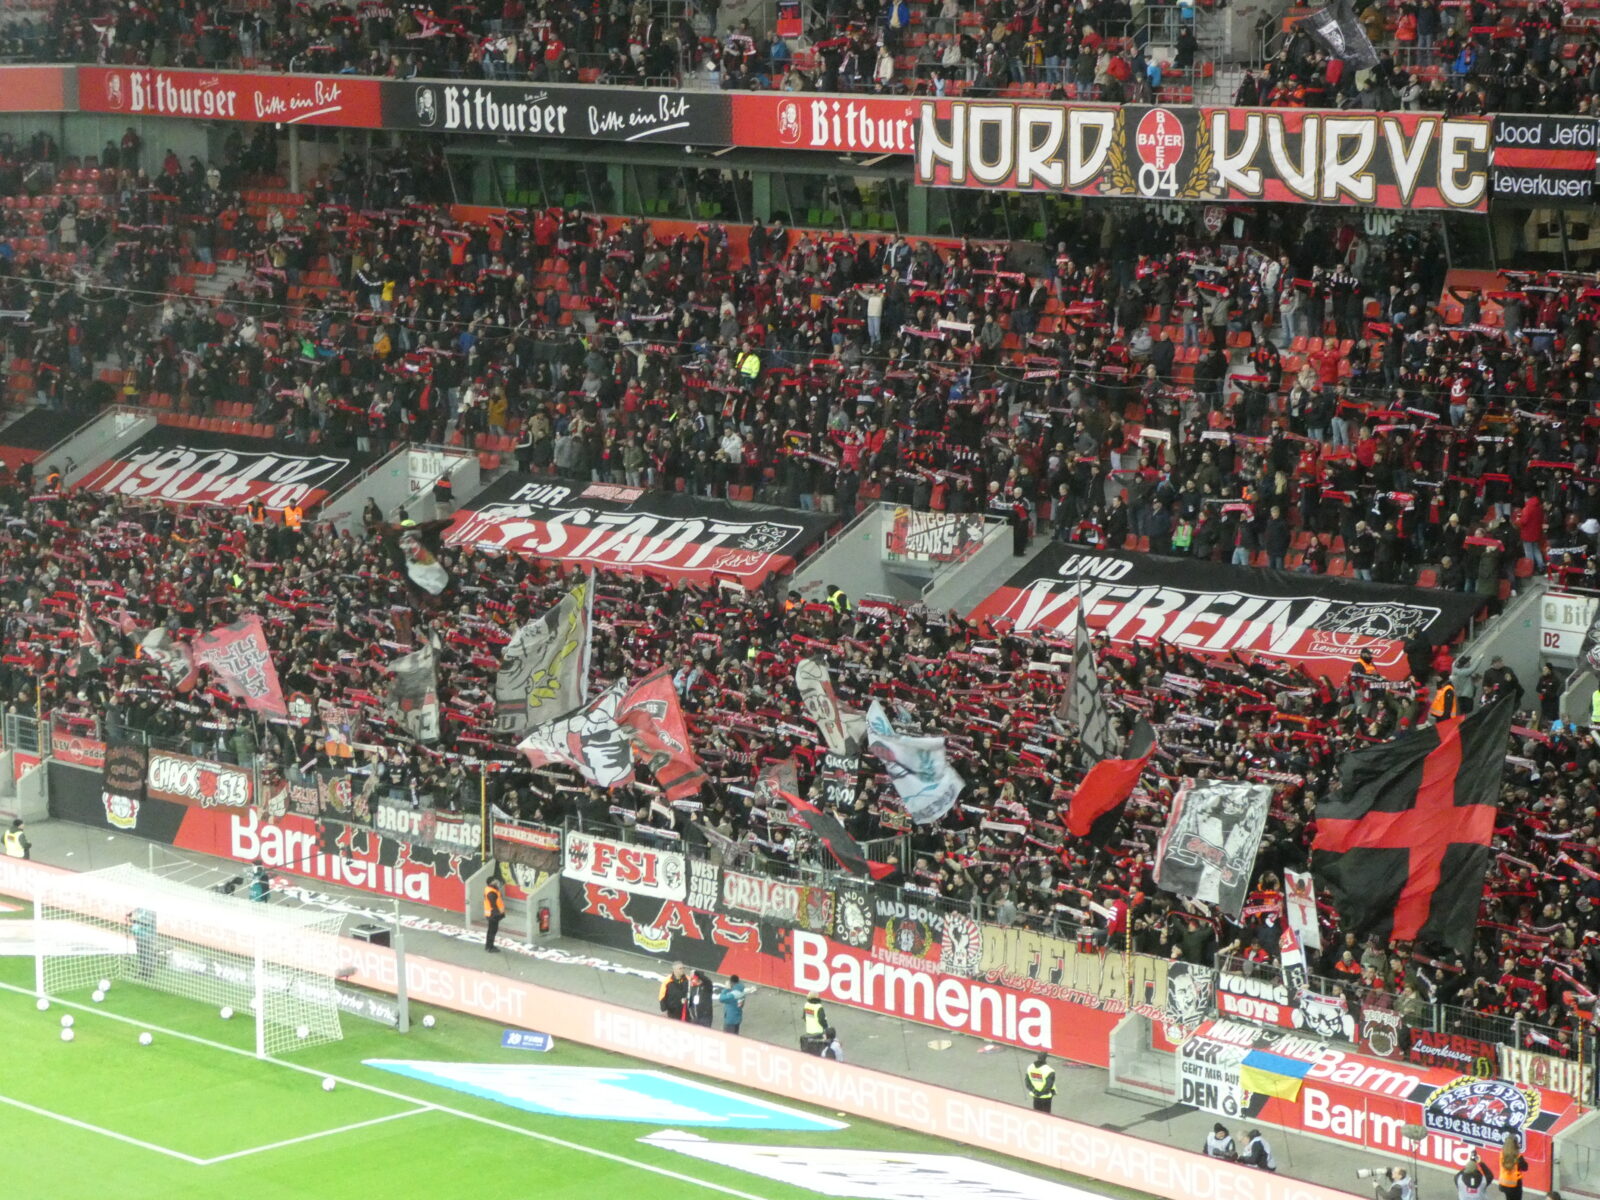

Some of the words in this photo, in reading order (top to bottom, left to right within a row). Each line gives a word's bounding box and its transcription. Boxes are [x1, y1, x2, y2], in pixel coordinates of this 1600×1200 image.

[130, 71, 236, 116] Bitburger
[255, 92, 287, 117] Bitte
[290, 93, 313, 110] ein
[315, 80, 342, 105] Bit
[444, 86, 567, 133] Bitburger
[588, 106, 625, 134] Bitte
[627, 111, 657, 127] ein
[658, 95, 690, 122] Bit
[1138, 133, 1182, 147] BAYER
[1155, 112, 1167, 169] BAYER
[1495, 121, 1542, 144] Jood
[918, 101, 1117, 188] NORD
[1208, 108, 1490, 208] KURVE
[1138, 163, 1179, 197] 04
[1494, 171, 1592, 196] Leverkusen
[509, 482, 571, 506] FÜR
[523, 508, 753, 568] STADT
[1058, 555, 1133, 581] UND
[1014, 580, 1330, 654] VEREIN
[1543, 632, 1560, 649] D2
[591, 841, 658, 887] FSI
[690, 860, 719, 881] WEST
[690, 877, 719, 897] SIDE
[875, 900, 907, 918] MAD
[792, 929, 1053, 1050] Barmenia
[1219, 972, 1289, 1006] YOUNG
[1182, 1036, 1224, 1065] DER
[1181, 1061, 1204, 1078] GEHT
[1204, 1067, 1223, 1082] MIR
[594, 1009, 736, 1075] HEIMSPIEL
[741, 1045, 793, 1089] FÜR
[799, 1060, 937, 1131] SMARTES,
[946, 1095, 1253, 1200] ENERGIESPARENDES
[1182, 1077, 1219, 1111] DEN
